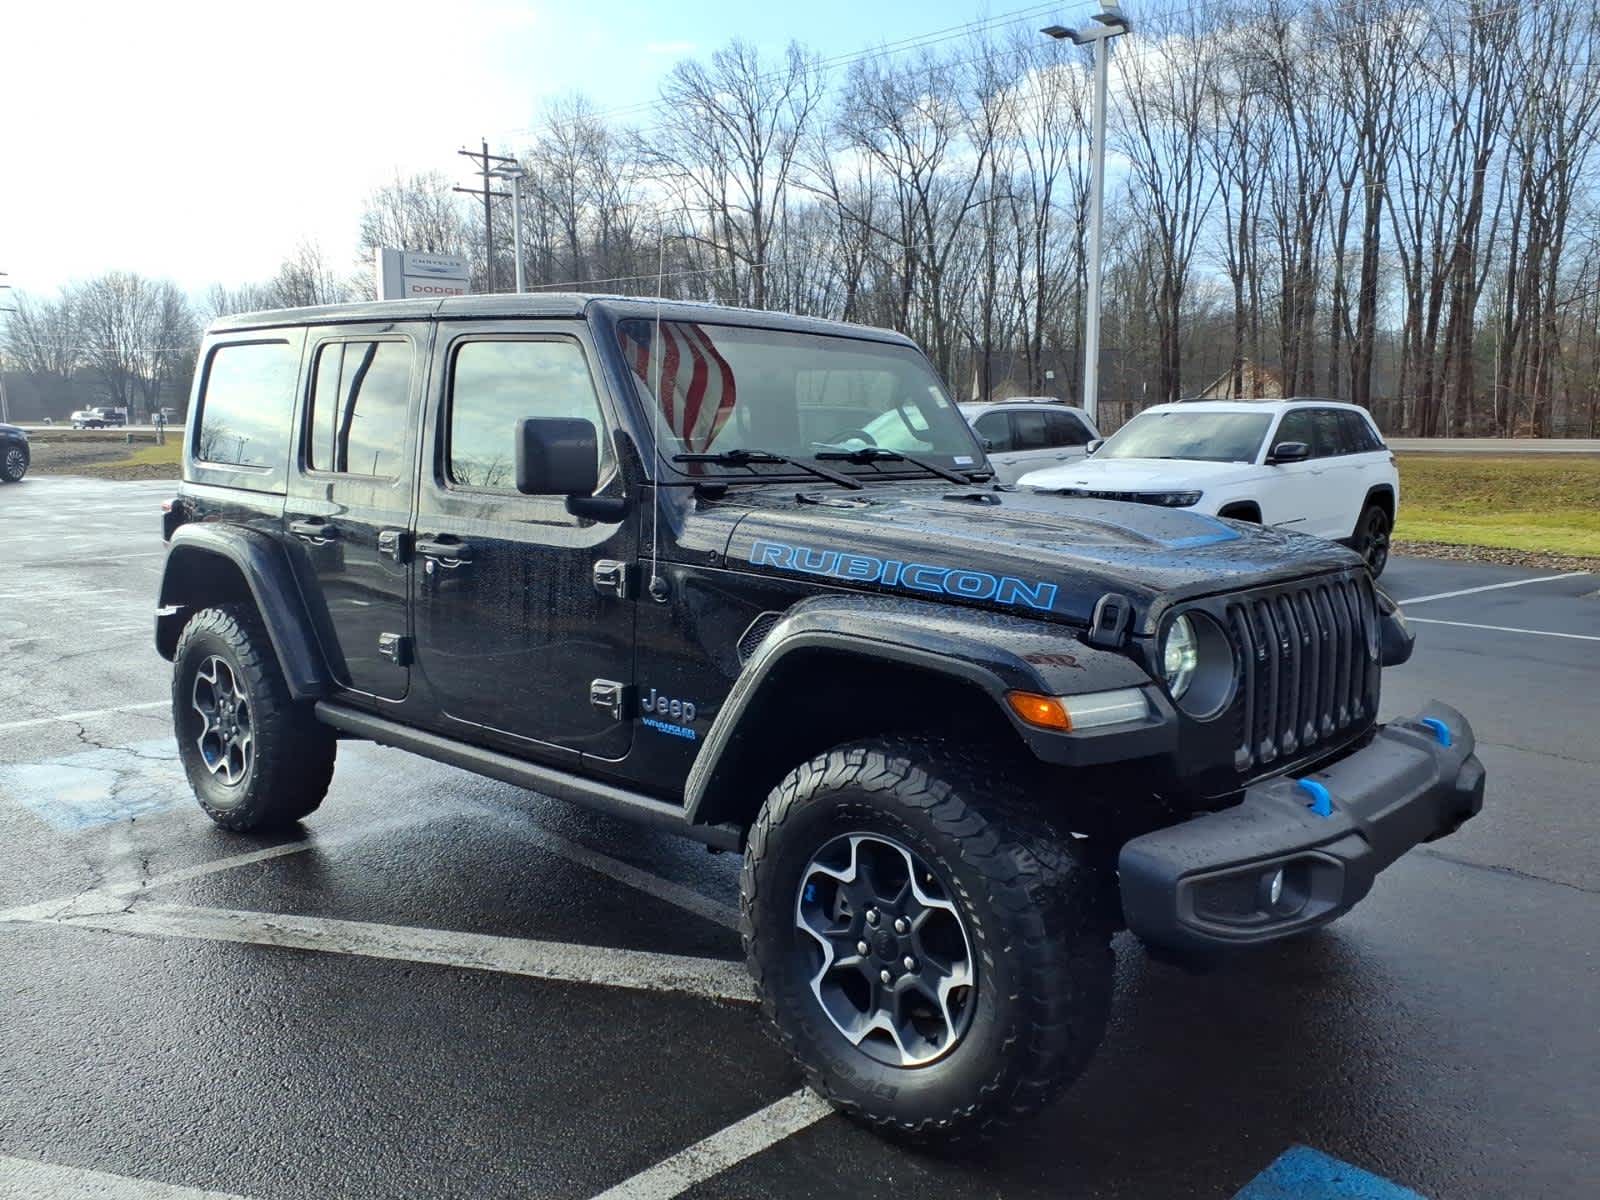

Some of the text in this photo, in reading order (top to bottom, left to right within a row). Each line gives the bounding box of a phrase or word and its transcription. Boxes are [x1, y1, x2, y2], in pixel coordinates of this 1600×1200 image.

[412, 285, 464, 296] DODGE
[749, 540, 1060, 611] RUBICON
[642, 688, 696, 724] Jeep
[642, 717, 695, 737] WRANGLER
